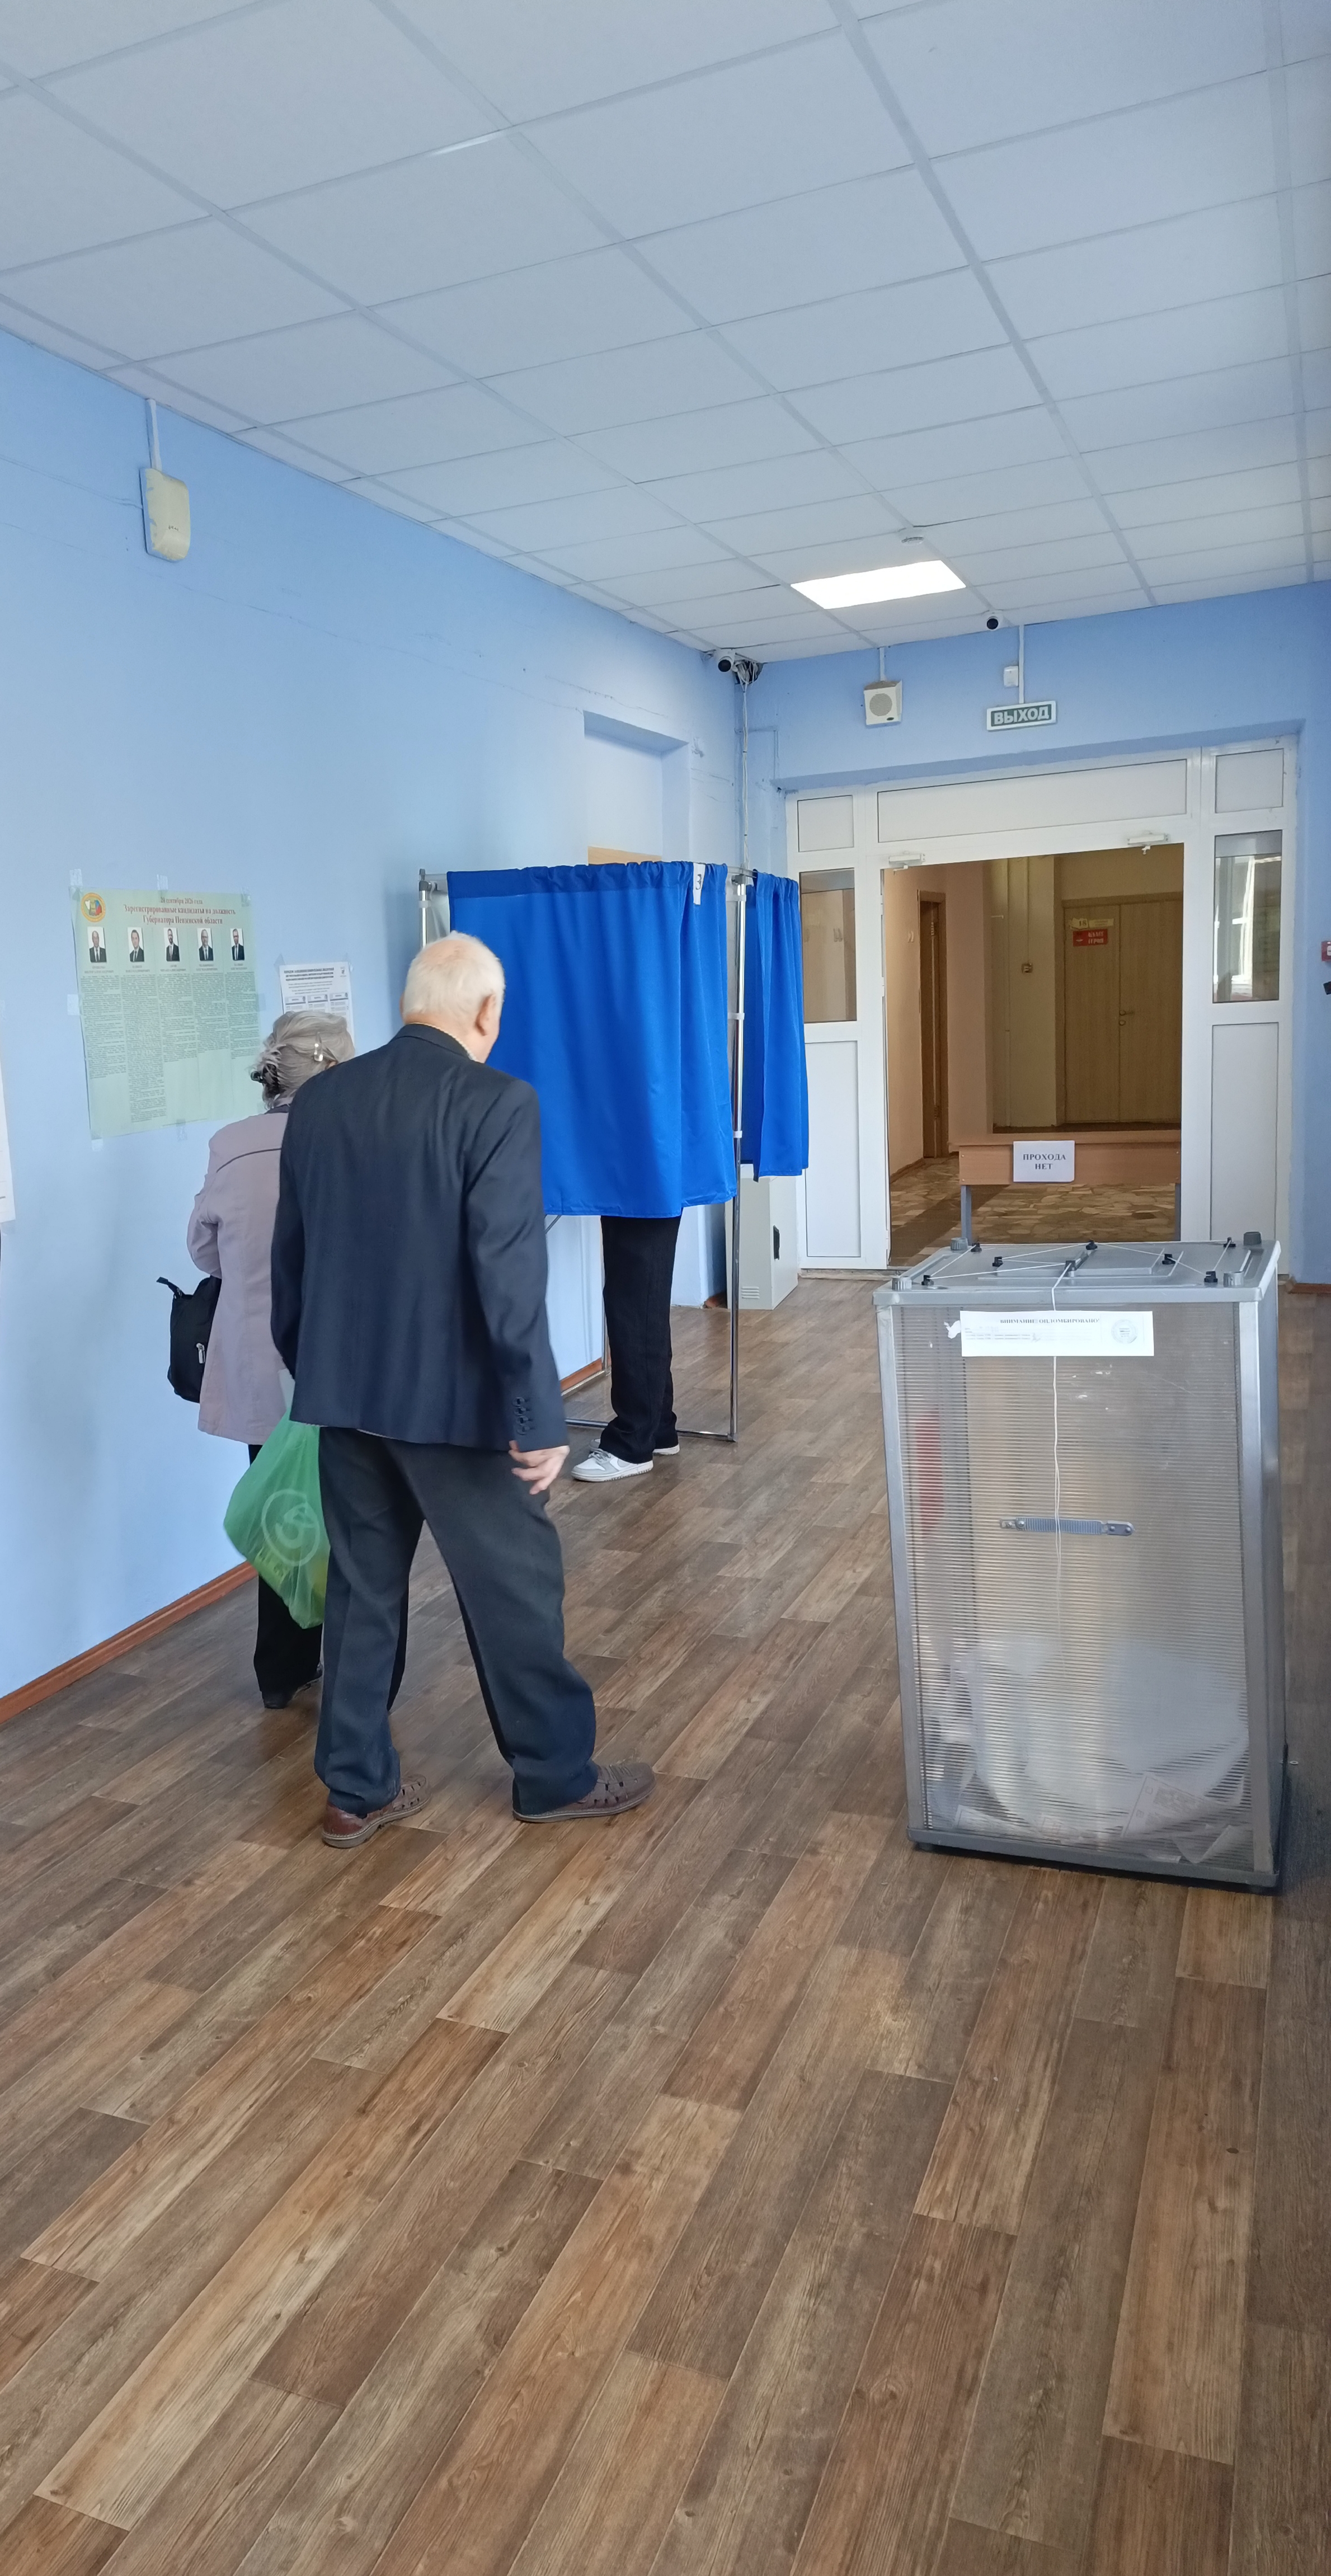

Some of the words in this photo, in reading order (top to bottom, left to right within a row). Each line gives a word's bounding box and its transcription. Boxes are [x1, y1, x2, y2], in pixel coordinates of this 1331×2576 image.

[994, 706, 1050, 725] ВЫХОД
[695, 873, 702, 890] 3
[166, 897, 184, 905] сентября
[123, 904, 177, 915] Зарегистрированные
[143, 915, 174, 925] Губернатора
